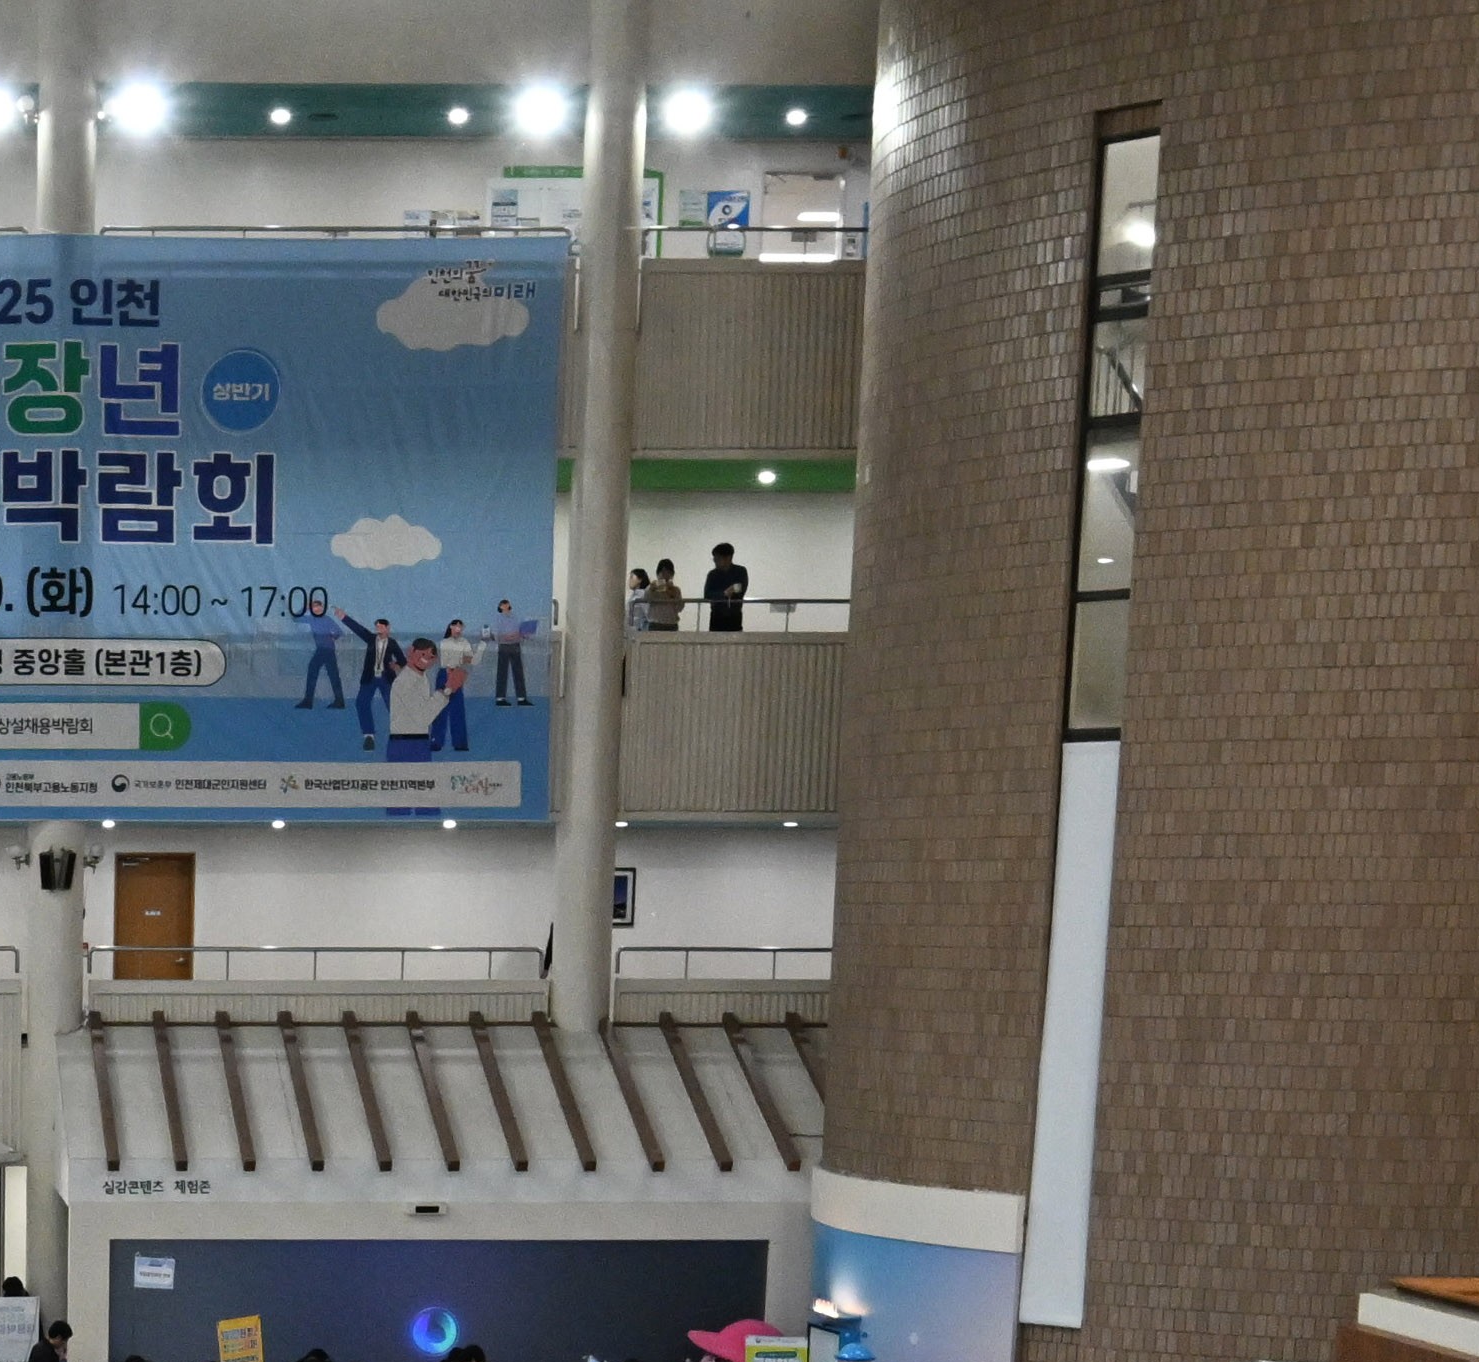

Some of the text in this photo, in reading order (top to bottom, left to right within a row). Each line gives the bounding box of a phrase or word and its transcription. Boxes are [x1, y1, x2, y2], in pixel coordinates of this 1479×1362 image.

[72, 278, 161, 328] 인천
[494, 281, 536, 300] 미래
[25, 565, 95, 619] (화)
[113, 584, 202, 617] 14:00
[242, 584, 330, 618] 17:00
[13, 647, 86, 679] 중앙홀
[93, 646, 203, 680] (본관1층)
[103, 1180, 211, 1195] 실감콘텐츠 체험존
